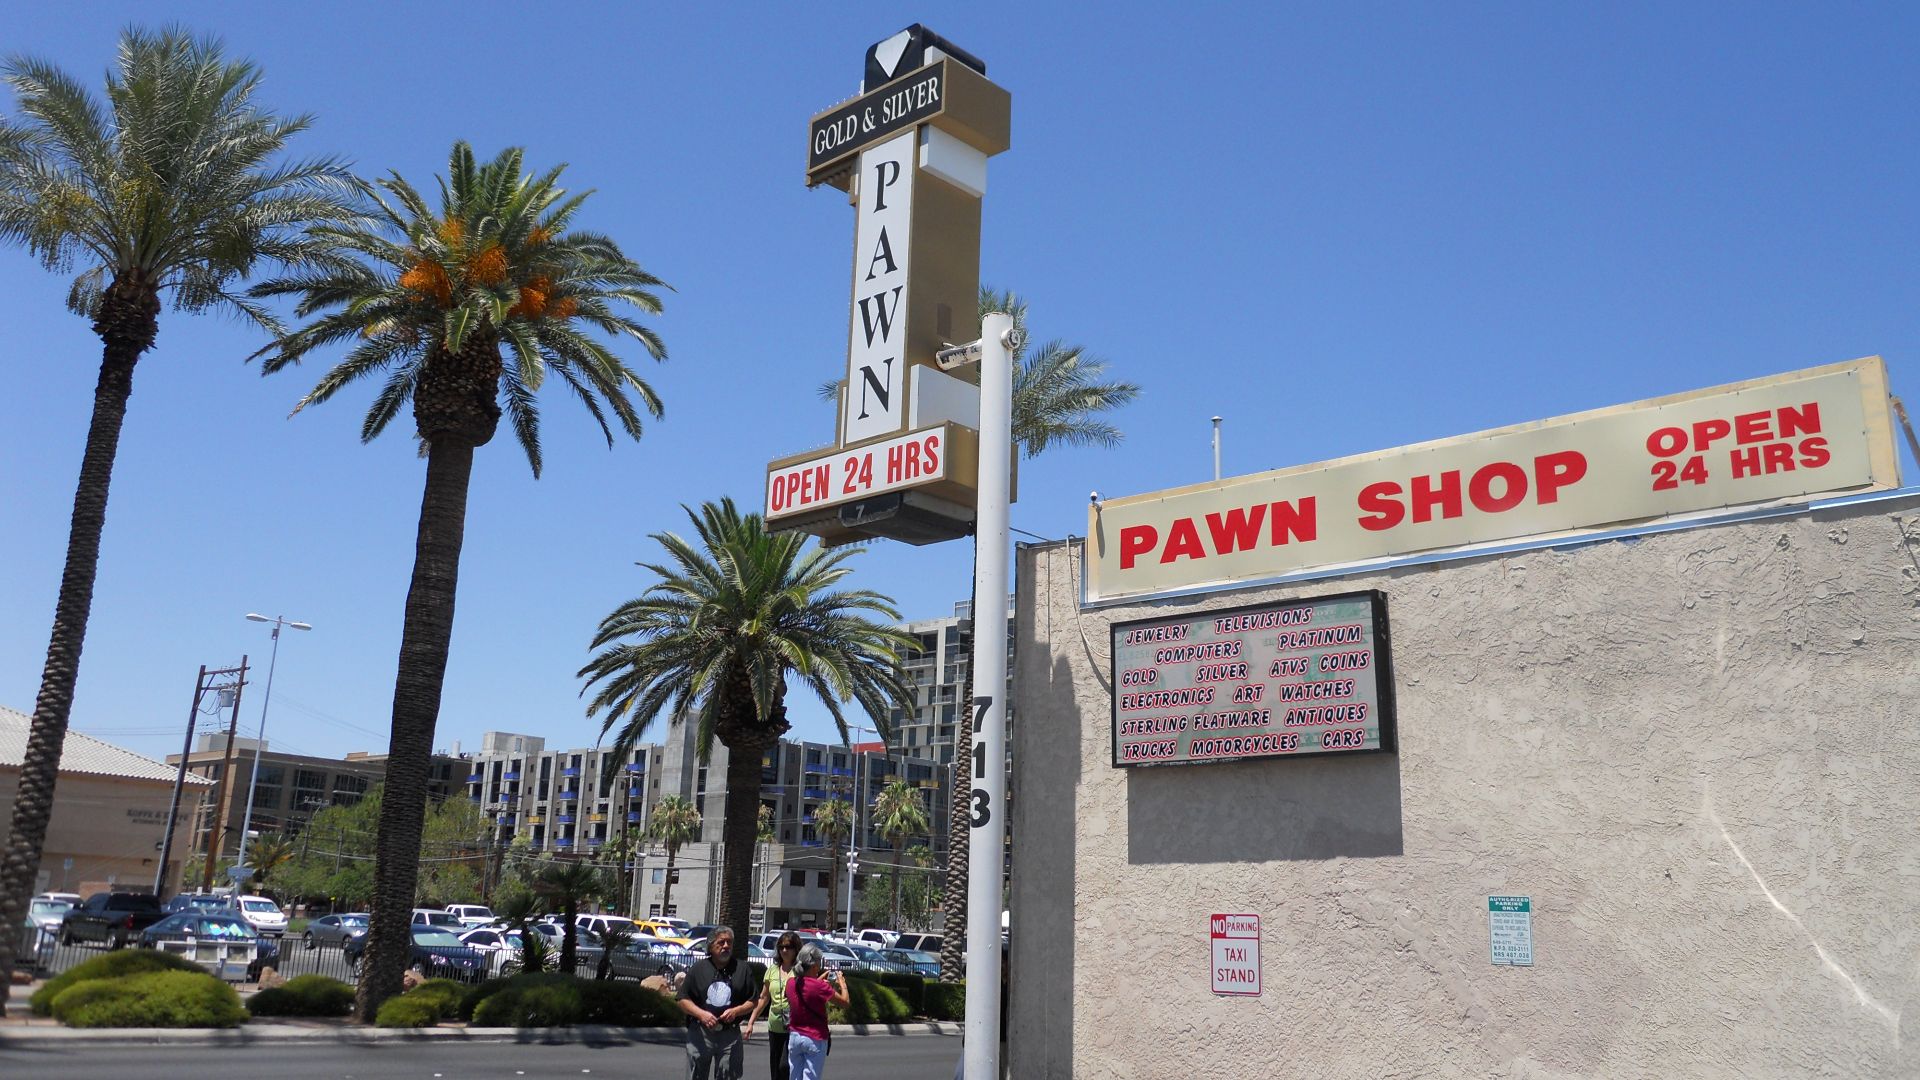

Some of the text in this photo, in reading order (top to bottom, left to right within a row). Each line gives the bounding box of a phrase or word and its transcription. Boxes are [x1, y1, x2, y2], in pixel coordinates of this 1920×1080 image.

[815, 76, 939, 155] GOLD & SILVER
[857, 160, 904, 420] PAWN
[1646, 402, 1821, 458] OPEN
[771, 435, 939, 511] OPEN 24 HRS
[1650, 437, 1831, 491] 24 HRS
[1120, 450, 1588, 570] PAWN SHOP
[1126, 607, 1313, 645] JEWELRY TELEVISIONS
[1155, 625, 1361, 664] COMPUTERS PLATINUM
[1122, 651, 1370, 686] GOLD SILVER ATVS COINS
[1121, 680, 1354, 709] ELECTRONICS ART WATCHES
[1120, 703, 1367, 735] STERLING FLATWARE ANTIQUES
[970, 695, 992, 828] 713
[1123, 729, 1364, 759] TRUCKS MOTORCYCLES CARS
[1212, 919, 1257, 934] NO PARKING
[1224, 947, 1247, 962] TAXI
[1217, 968, 1255, 983] STAND
